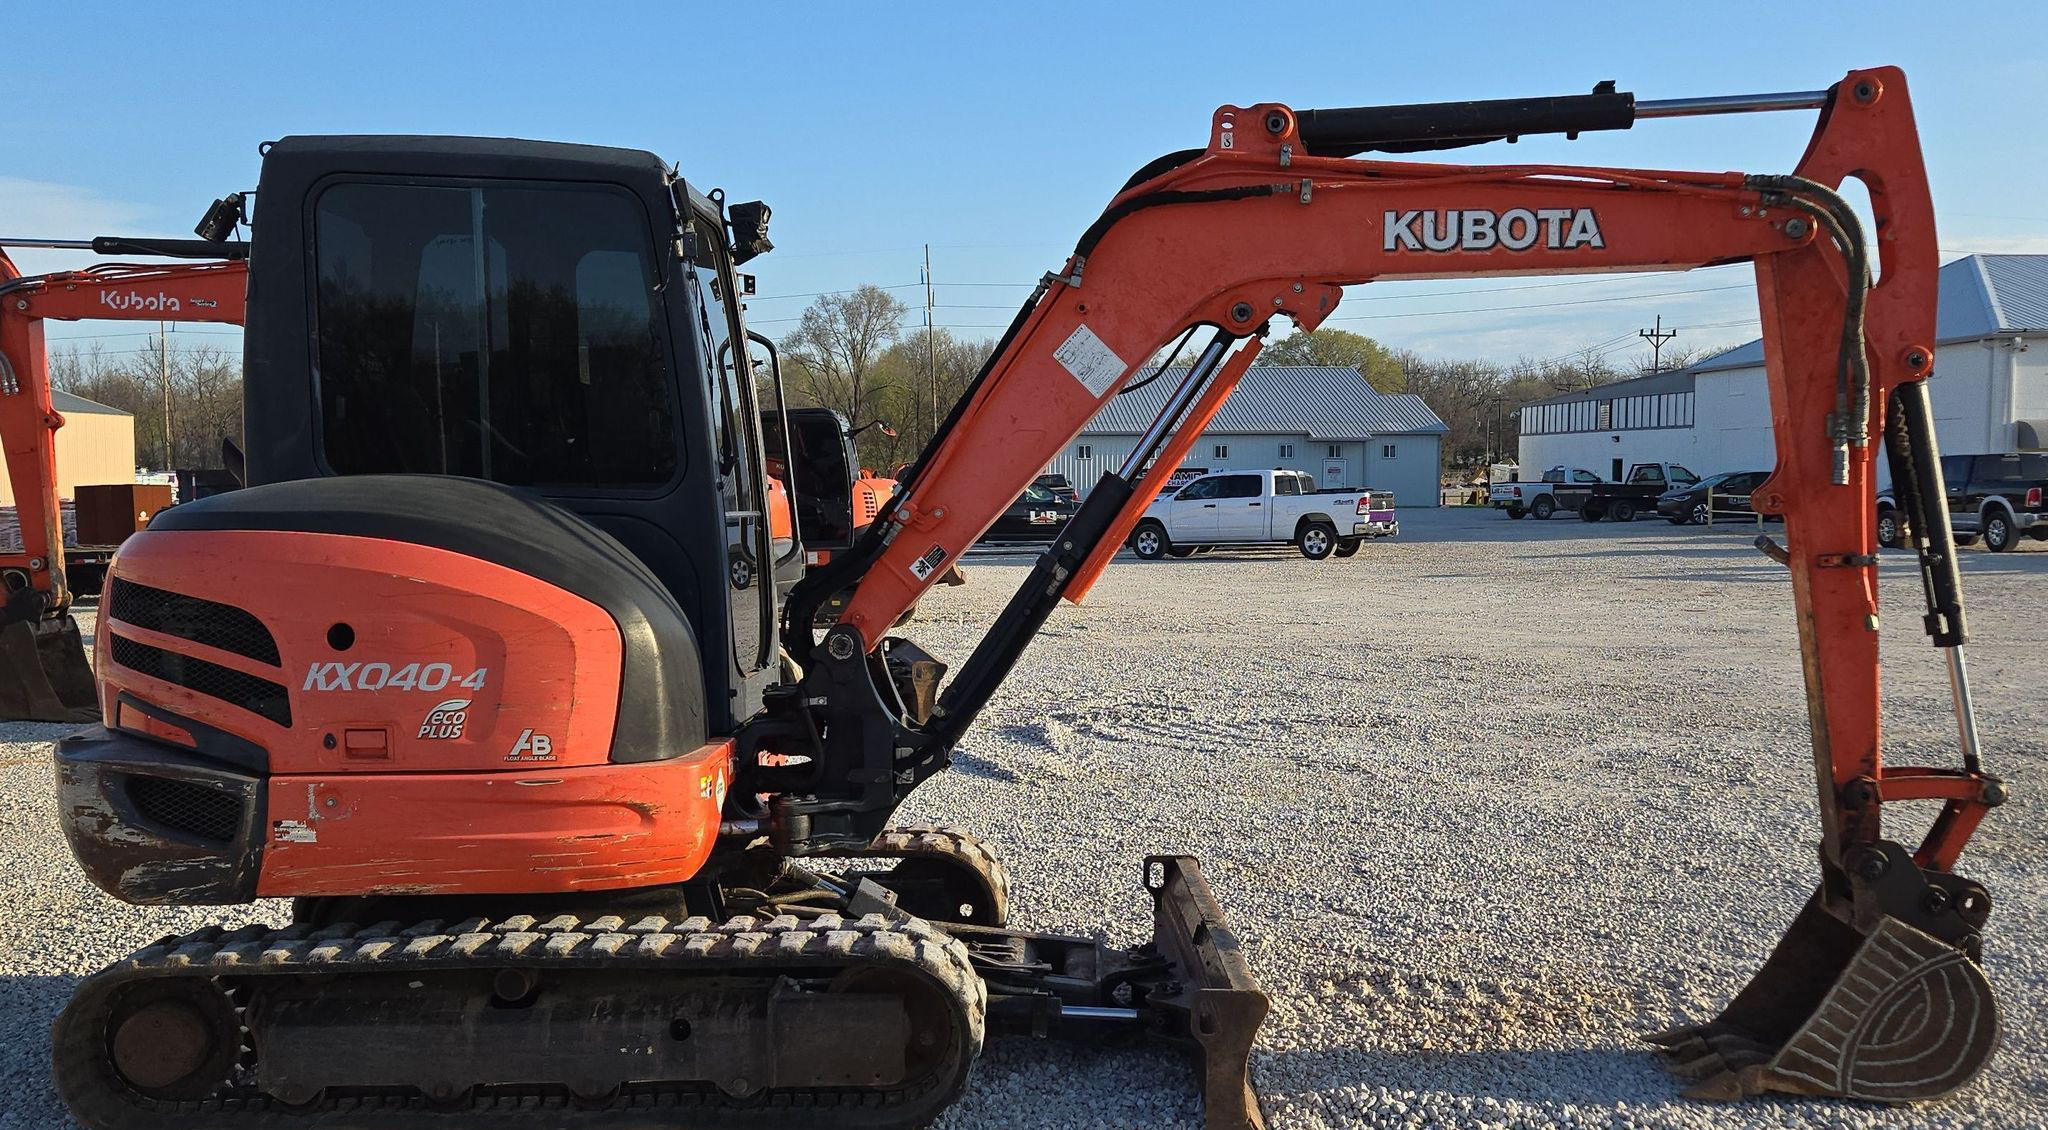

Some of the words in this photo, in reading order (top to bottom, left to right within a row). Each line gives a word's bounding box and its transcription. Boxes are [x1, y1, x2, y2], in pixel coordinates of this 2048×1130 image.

[1383, 208, 1606, 251] KUBOTA
[100, 290, 180, 311] Kubota
[302, 662, 488, 692] KX040-4
[431, 711, 466, 725] eco
[417, 725, 463, 739] PLUS
